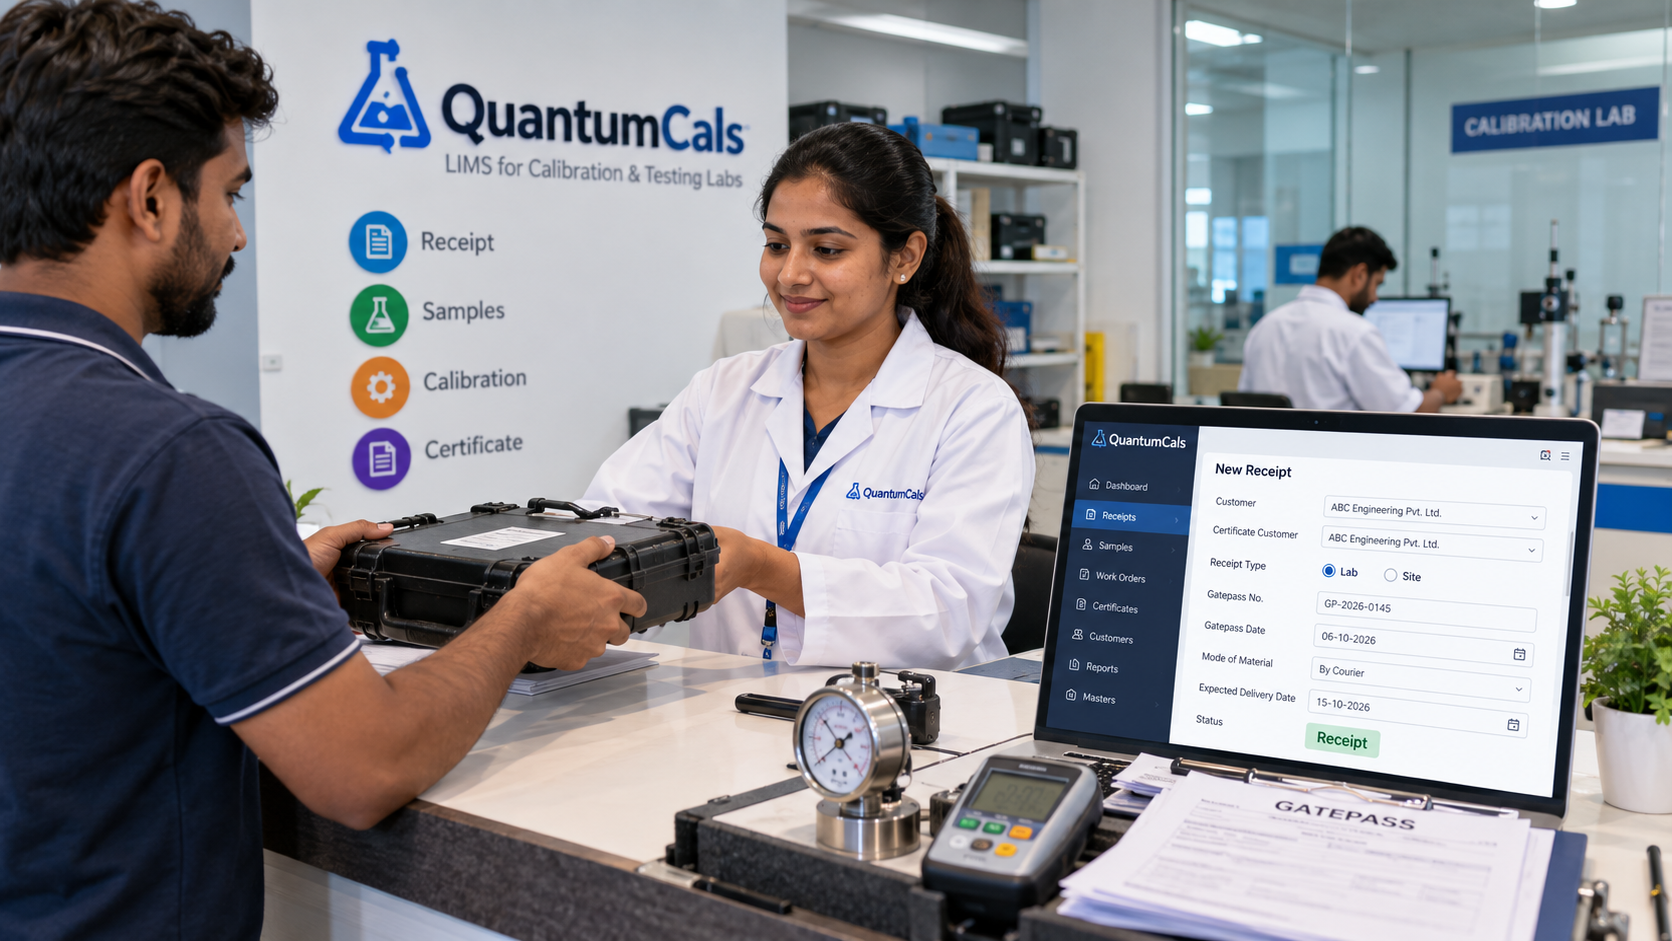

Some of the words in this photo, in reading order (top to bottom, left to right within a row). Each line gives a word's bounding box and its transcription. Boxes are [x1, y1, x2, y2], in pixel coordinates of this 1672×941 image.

[441, 83, 744, 156] QuantumCals
[1464, 108, 1590, 137] CALIBRATION
[1595, 104, 1636, 128] LAB
[446, 154, 492, 175] LIMS
[498, 156, 523, 176] for
[529, 159, 623, 181] Calibration
[628, 165, 640, 182] &
[645, 166, 702, 190] Testing
[706, 169, 744, 188] Labs
[422, 232, 494, 256] Receipt
[423, 301, 505, 324] Samples
[424, 369, 526, 391] Calibration
[425, 436, 523, 459] Certificate
[1108, 433, 1187, 449] QuantumCals
[1215, 462, 1242, 476] New
[1245, 464, 1292, 480] Receipt
[1105, 480, 1149, 492] Dashboard
[863, 487, 925, 501] QuantumCals
[1215, 496, 1257, 508] Customer
[1102, 510, 1137, 523] Receipts
[1330, 502, 1350, 513] ABC
[1352, 503, 1404, 518] Engineering
[1405, 506, 1423, 517] Pvt.
[1425, 508, 1442, 518] Ltd.
[1212, 524, 1256, 537] Certificate
[1257, 527, 1299, 540] Customer
[1098, 540, 1134, 553] Samples
[1328, 533, 1348, 543] ABC
[1349, 533, 1402, 549] Engineering
[1403, 537, 1421, 548] Pvt.
[1422, 539, 1440, 549] Ltd.
[1210, 557, 1243, 570] Receipt
[1244, 559, 1267, 572] Type
[1095, 571, 1119, 582] Work
[1120, 573, 1146, 584] Orders
[1340, 567, 1359, 578] Lab
[1402, 571, 1422, 582] Site
[1207, 589, 1247, 602] Gatepass
[1248, 592, 1264, 603] No.
[1092, 601, 1139, 615] Certificates
[1324, 598, 1392, 614] GP-2026-0145
[1204, 620, 1244, 633] Gatepass
[1245, 624, 1266, 635] Date
[1089, 631, 1134, 645] Customers
[1321, 631, 1377, 646] 06-10-2026
[1201, 651, 1226, 663] Mode
[1227, 654, 1237, 664] of
[1238, 655, 1274, 668] Material
[1086, 661, 1119, 674] Reports
[1319, 664, 1330, 676] By
[1332, 665, 1365, 678] Courier
[1082, 692, 1116, 705] Masters
[1198, 682, 1238, 696] Expected
[1240, 687, 1275, 702] Delivery
[1277, 691, 1297, 703] Date
[1317, 697, 1371, 713] 15-10-2026
[1195, 714, 1224, 727] Status
[1317, 731, 1368, 751] Receipt
[1274, 800, 1416, 830] GATEPASS
